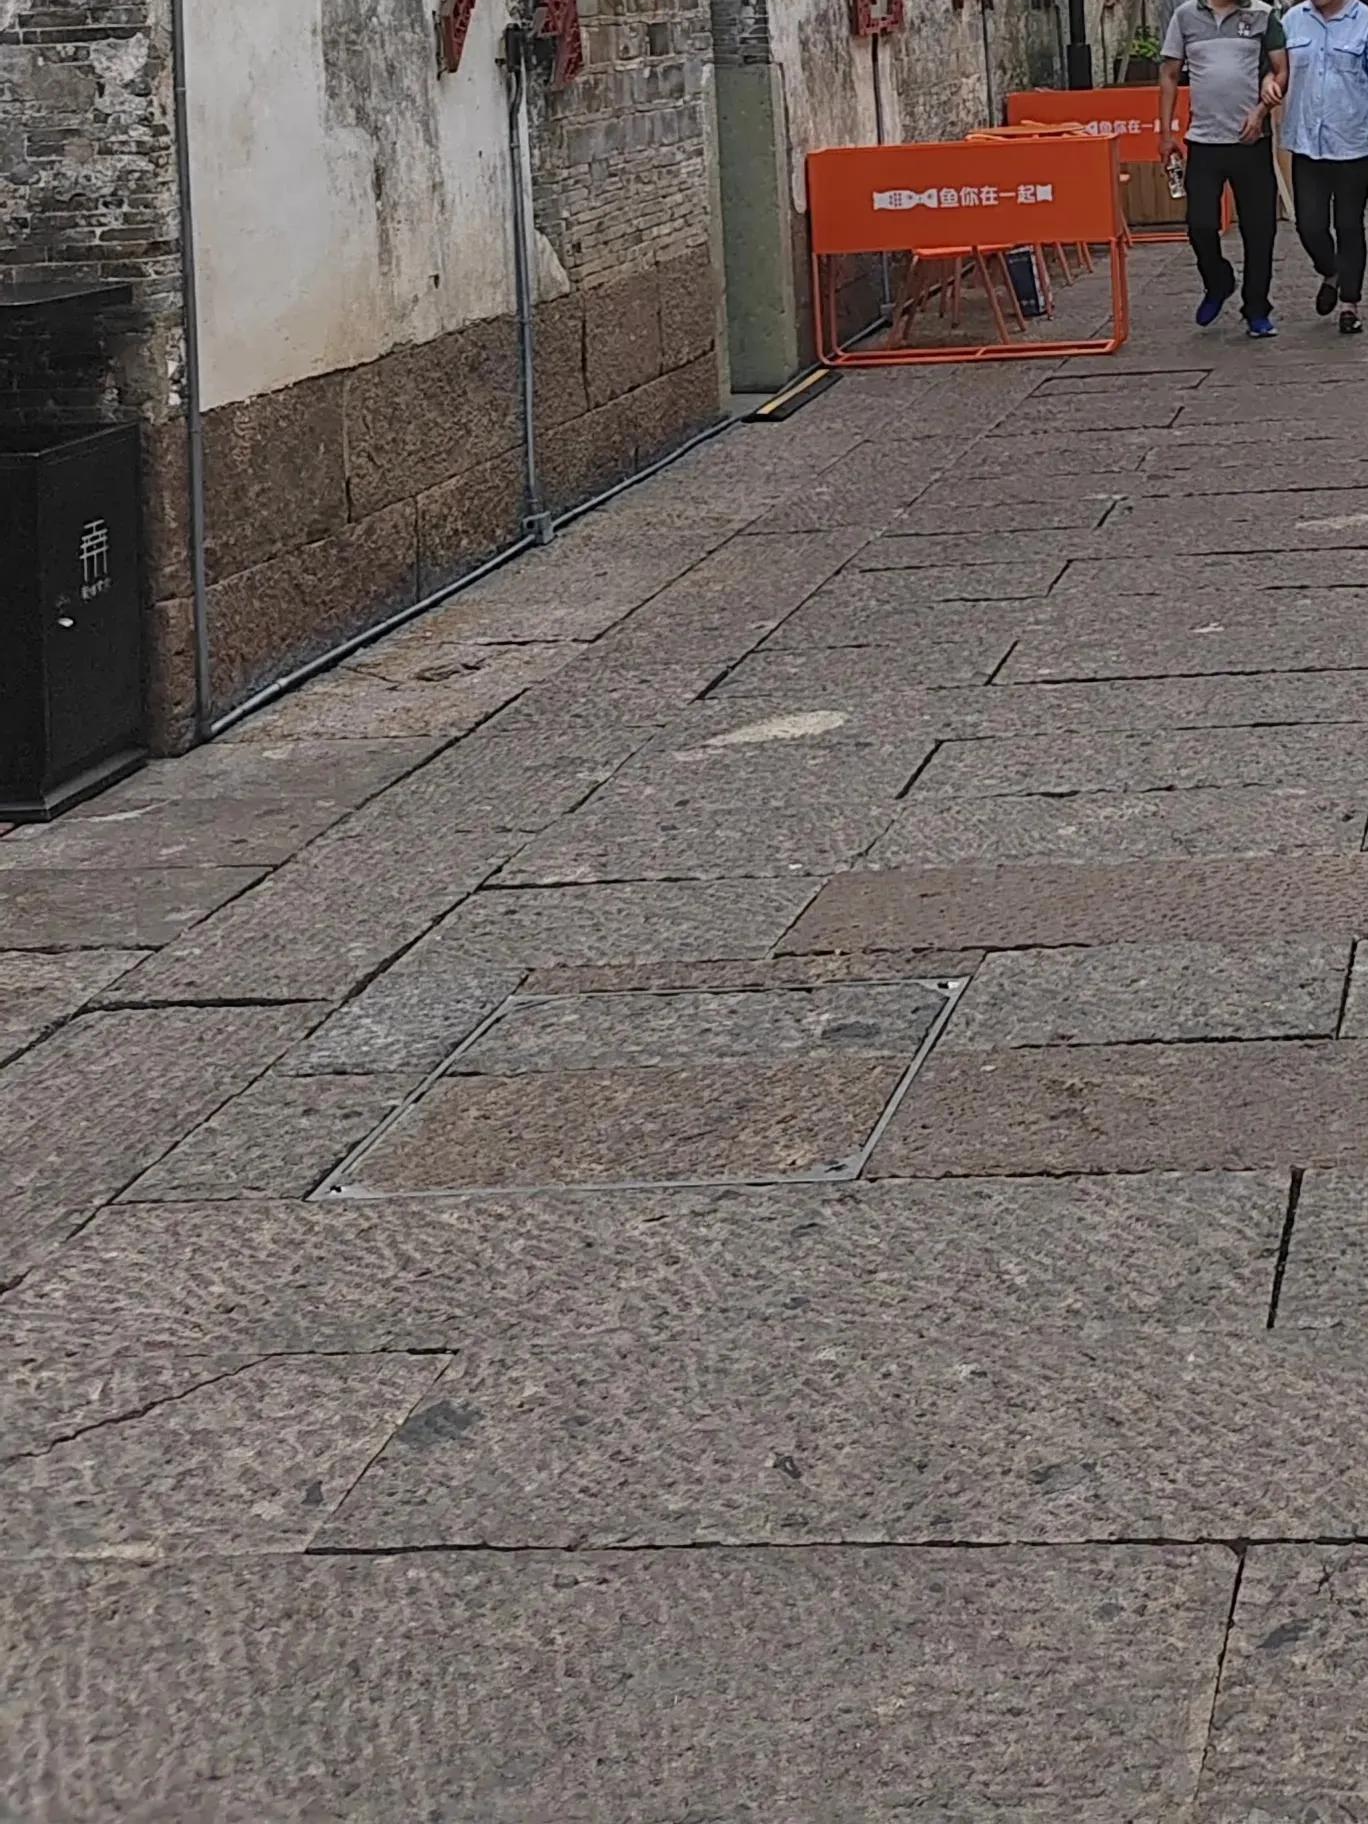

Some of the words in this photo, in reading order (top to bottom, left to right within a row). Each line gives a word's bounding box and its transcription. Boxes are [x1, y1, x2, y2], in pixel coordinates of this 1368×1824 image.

[938, 183, 1036, 208] 鱼你在一起
